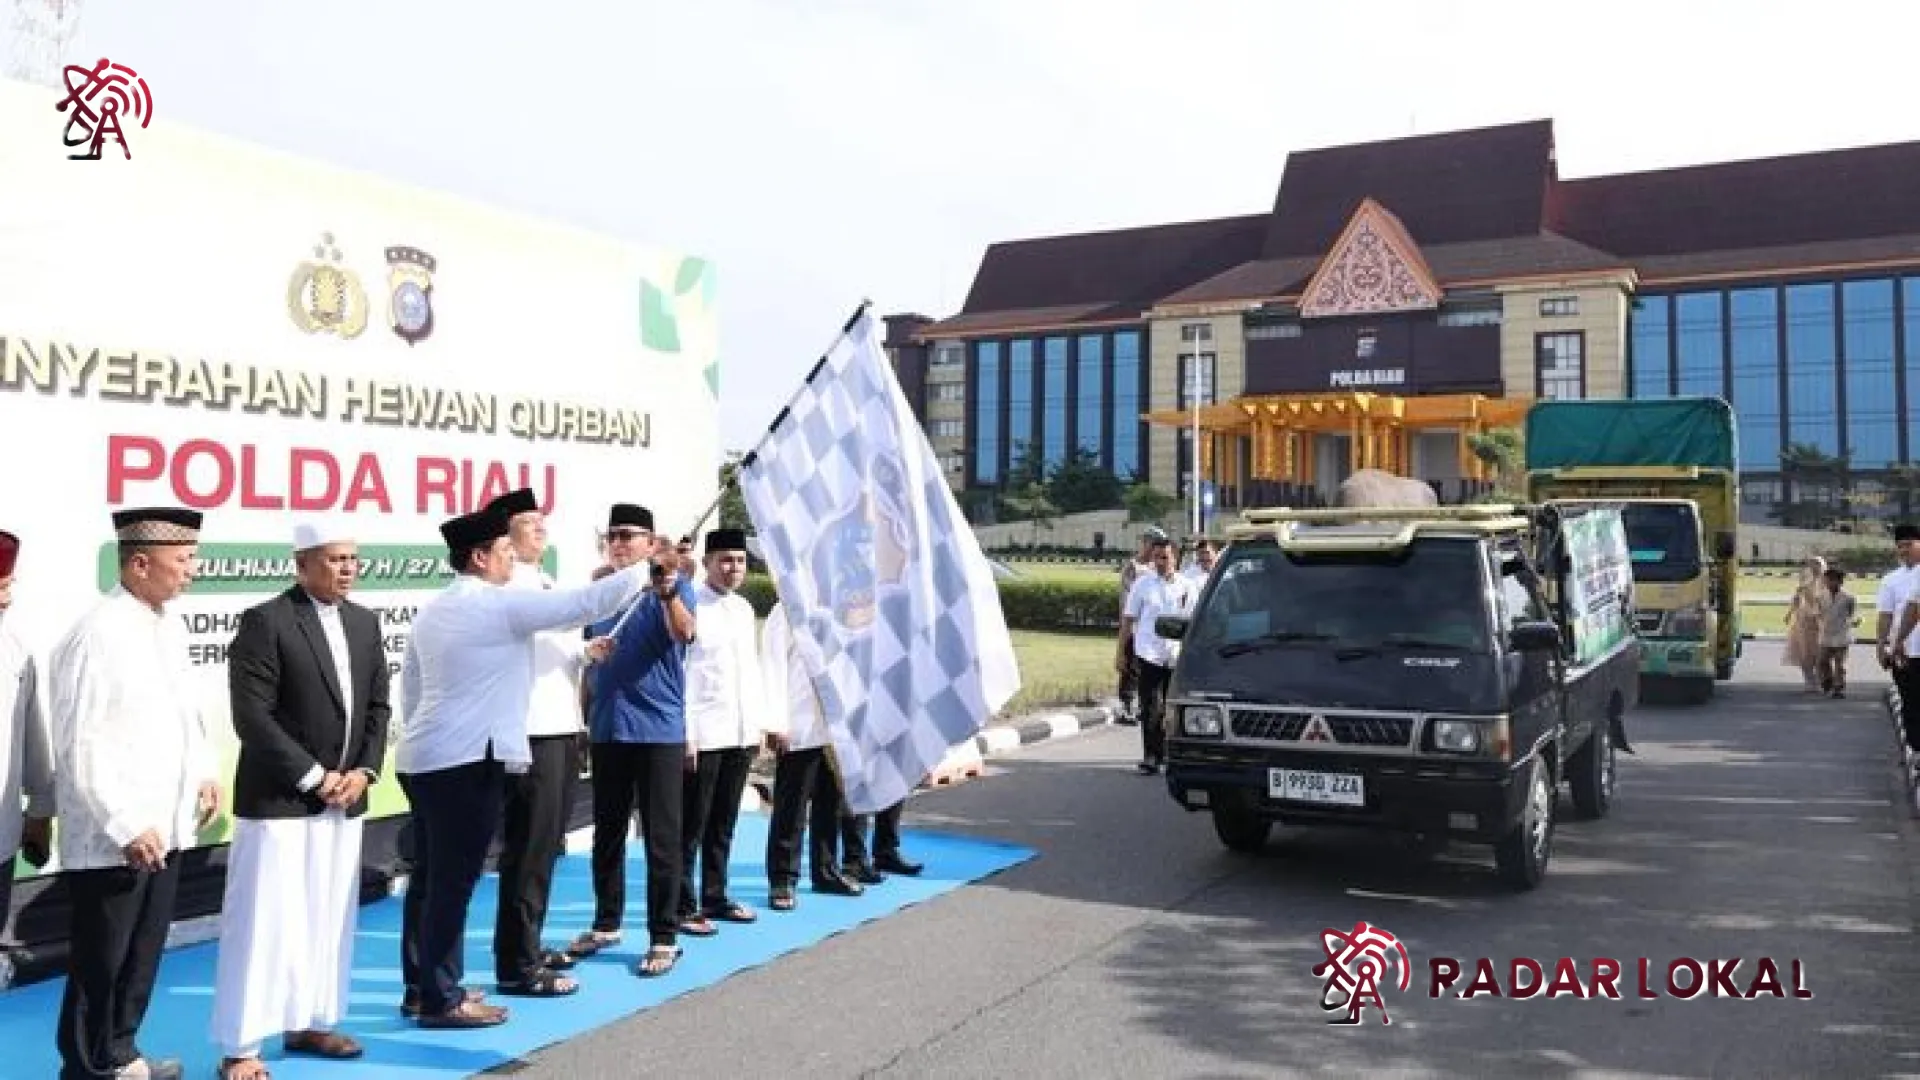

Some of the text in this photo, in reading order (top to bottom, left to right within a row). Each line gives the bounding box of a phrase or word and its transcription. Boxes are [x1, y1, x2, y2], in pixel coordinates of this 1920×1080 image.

[0, 336, 651, 447] NYERAHAN HEWAN QURBAN
[106, 432, 556, 516] POLDA RIAU
[194, 558, 298, 581] ZULHIJJA
[376, 557, 394, 578] H
[407, 557, 437, 578] 27
[1272, 772, 1282, 788] B
